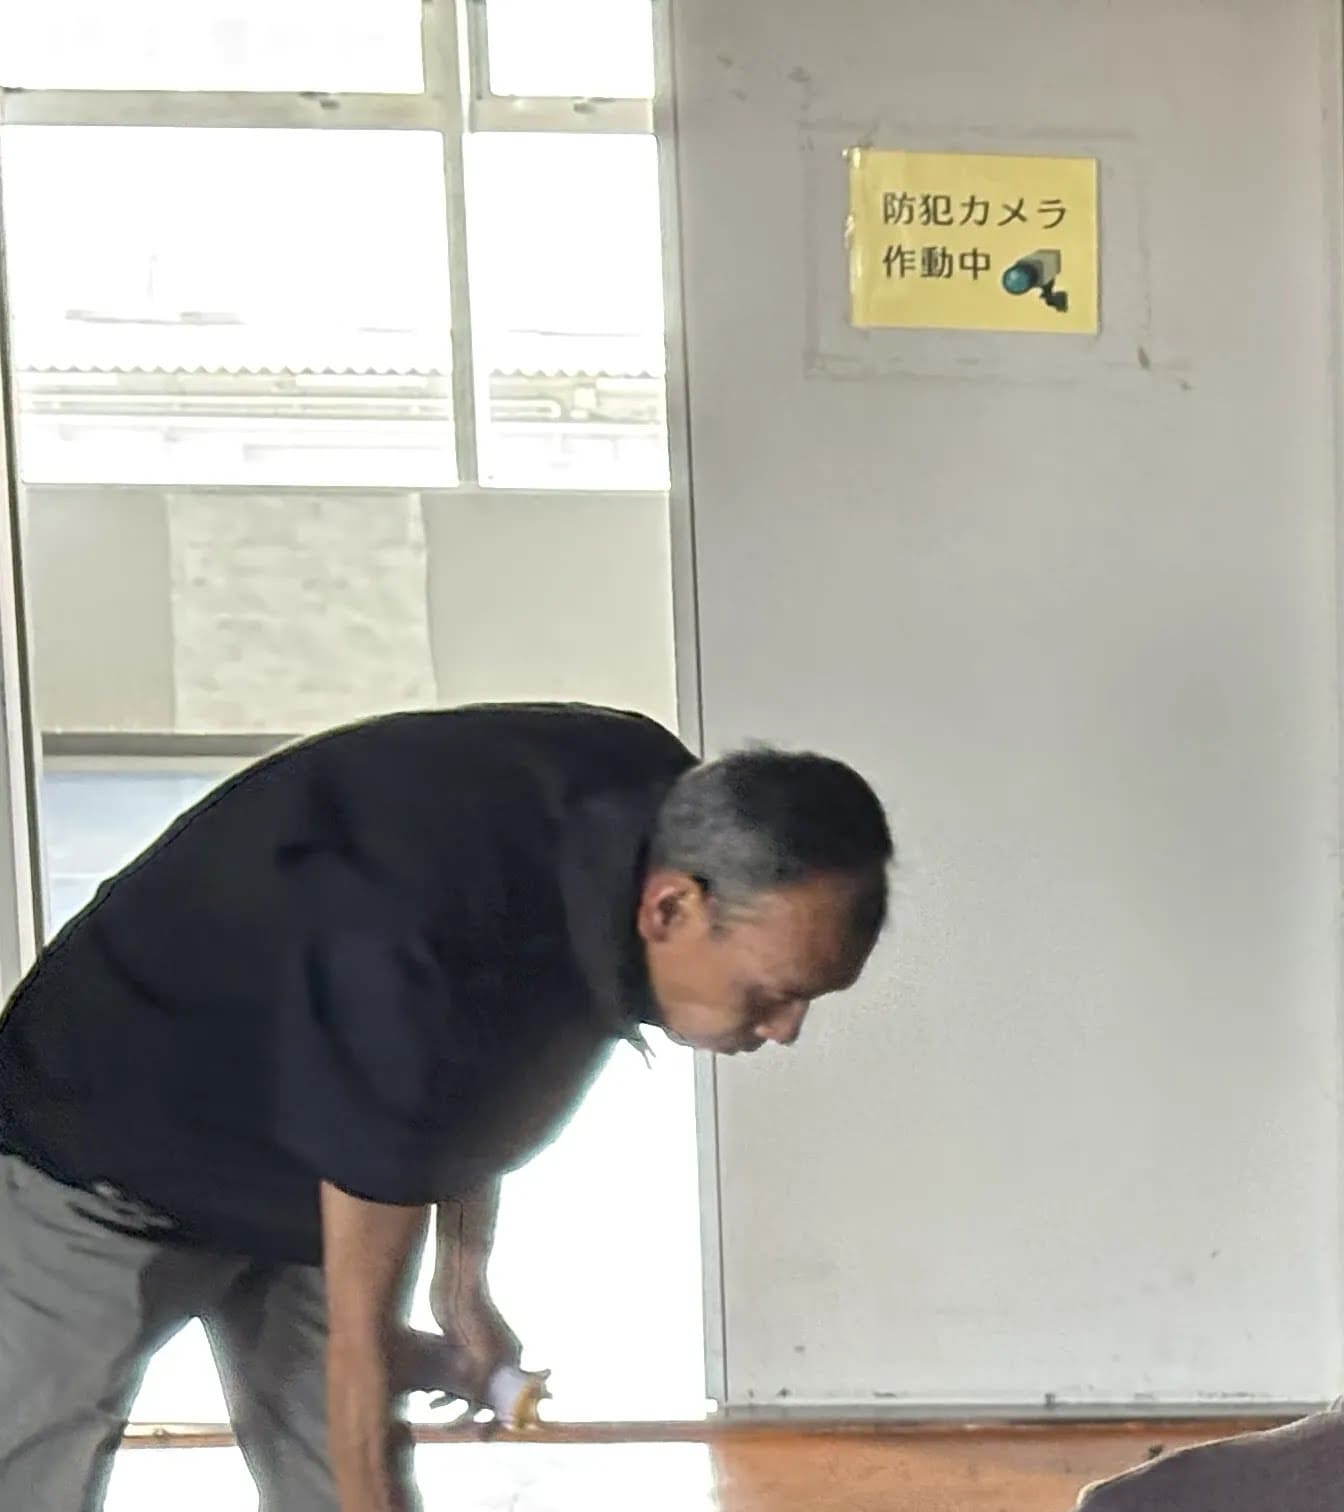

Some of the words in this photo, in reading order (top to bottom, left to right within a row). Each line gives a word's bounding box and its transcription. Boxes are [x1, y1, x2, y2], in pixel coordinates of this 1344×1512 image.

[882, 192, 1067, 229] 防犯カメラ
[882, 245, 992, 281] 作動中
